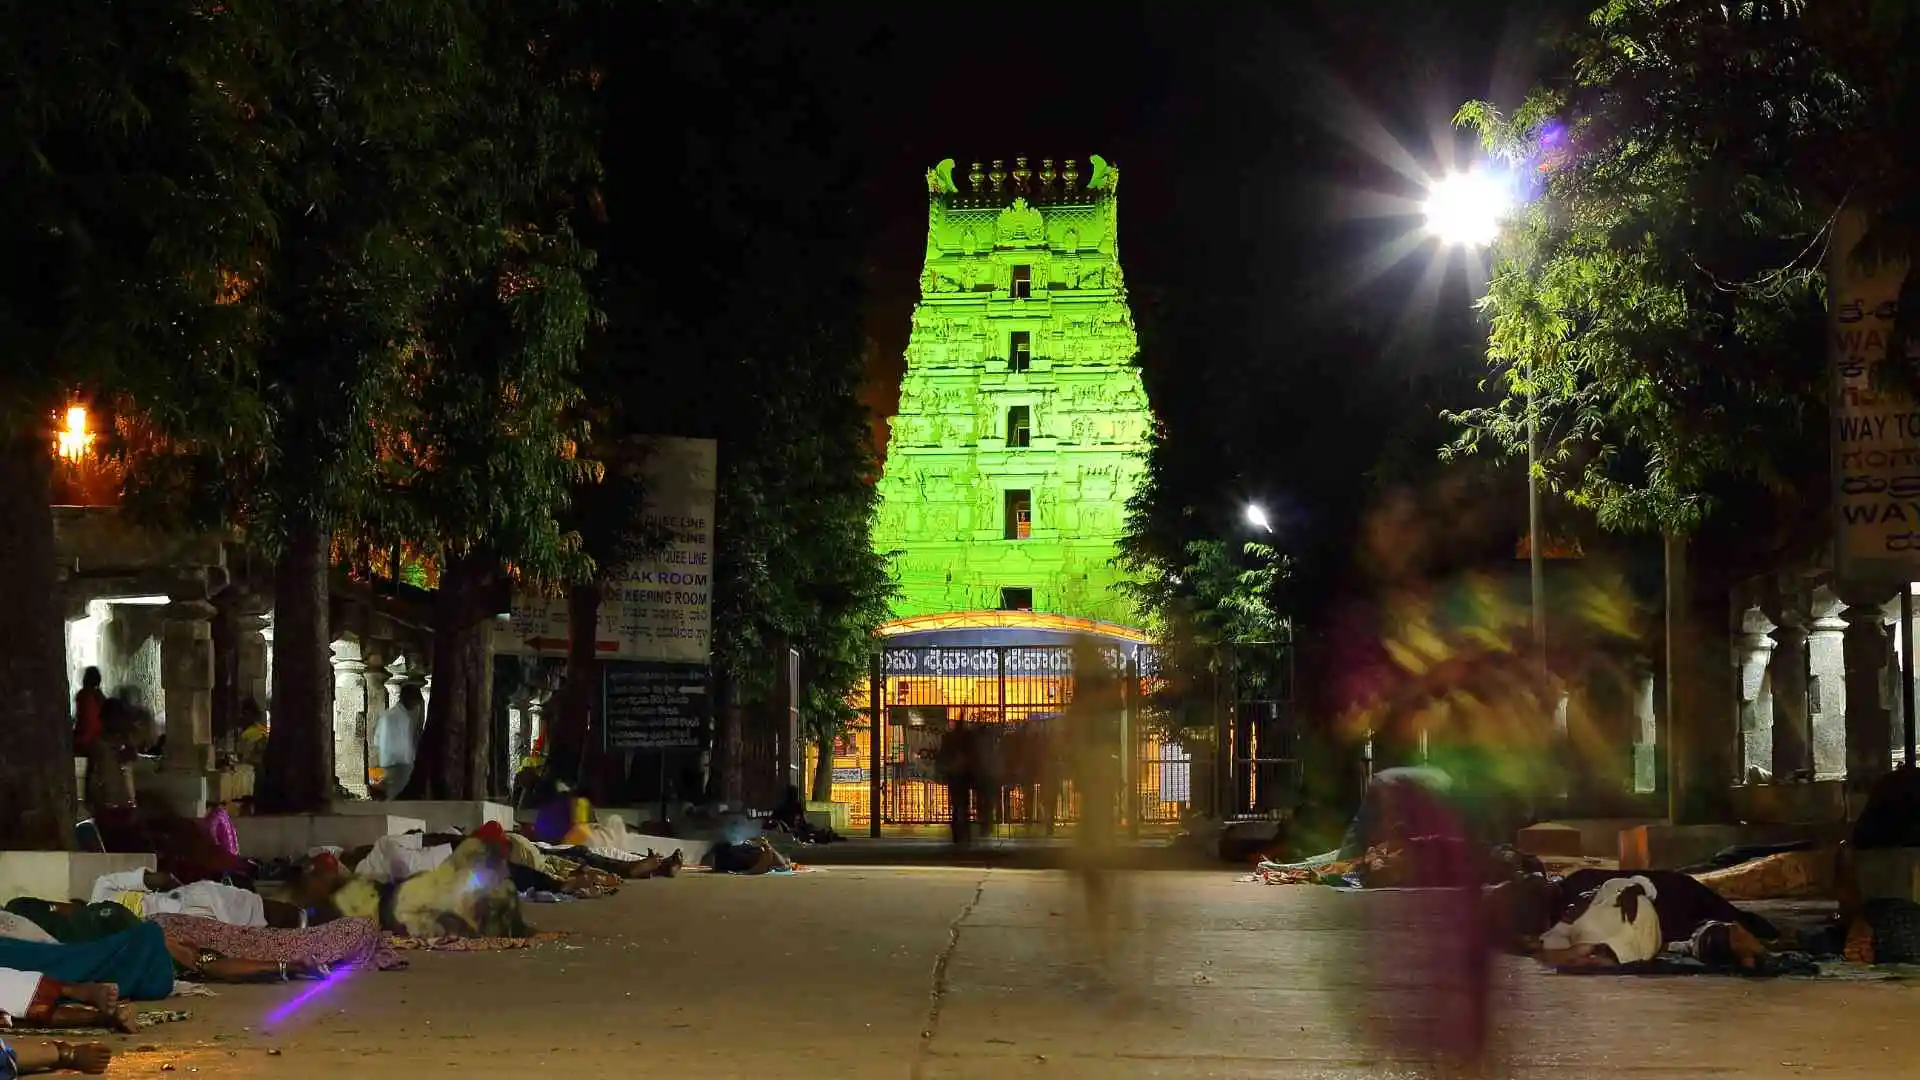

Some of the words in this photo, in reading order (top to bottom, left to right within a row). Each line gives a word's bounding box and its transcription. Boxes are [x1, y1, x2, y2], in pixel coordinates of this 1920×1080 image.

[1840, 414, 1887, 442] WAY
[681, 518, 705, 529] LINE
[680, 532, 706, 544] LINE
[688, 551, 708, 565] LINE
[658, 572, 707, 586] ROOM
[624, 588, 671, 604] KEEPING
[674, 591, 707, 606] ROOM
